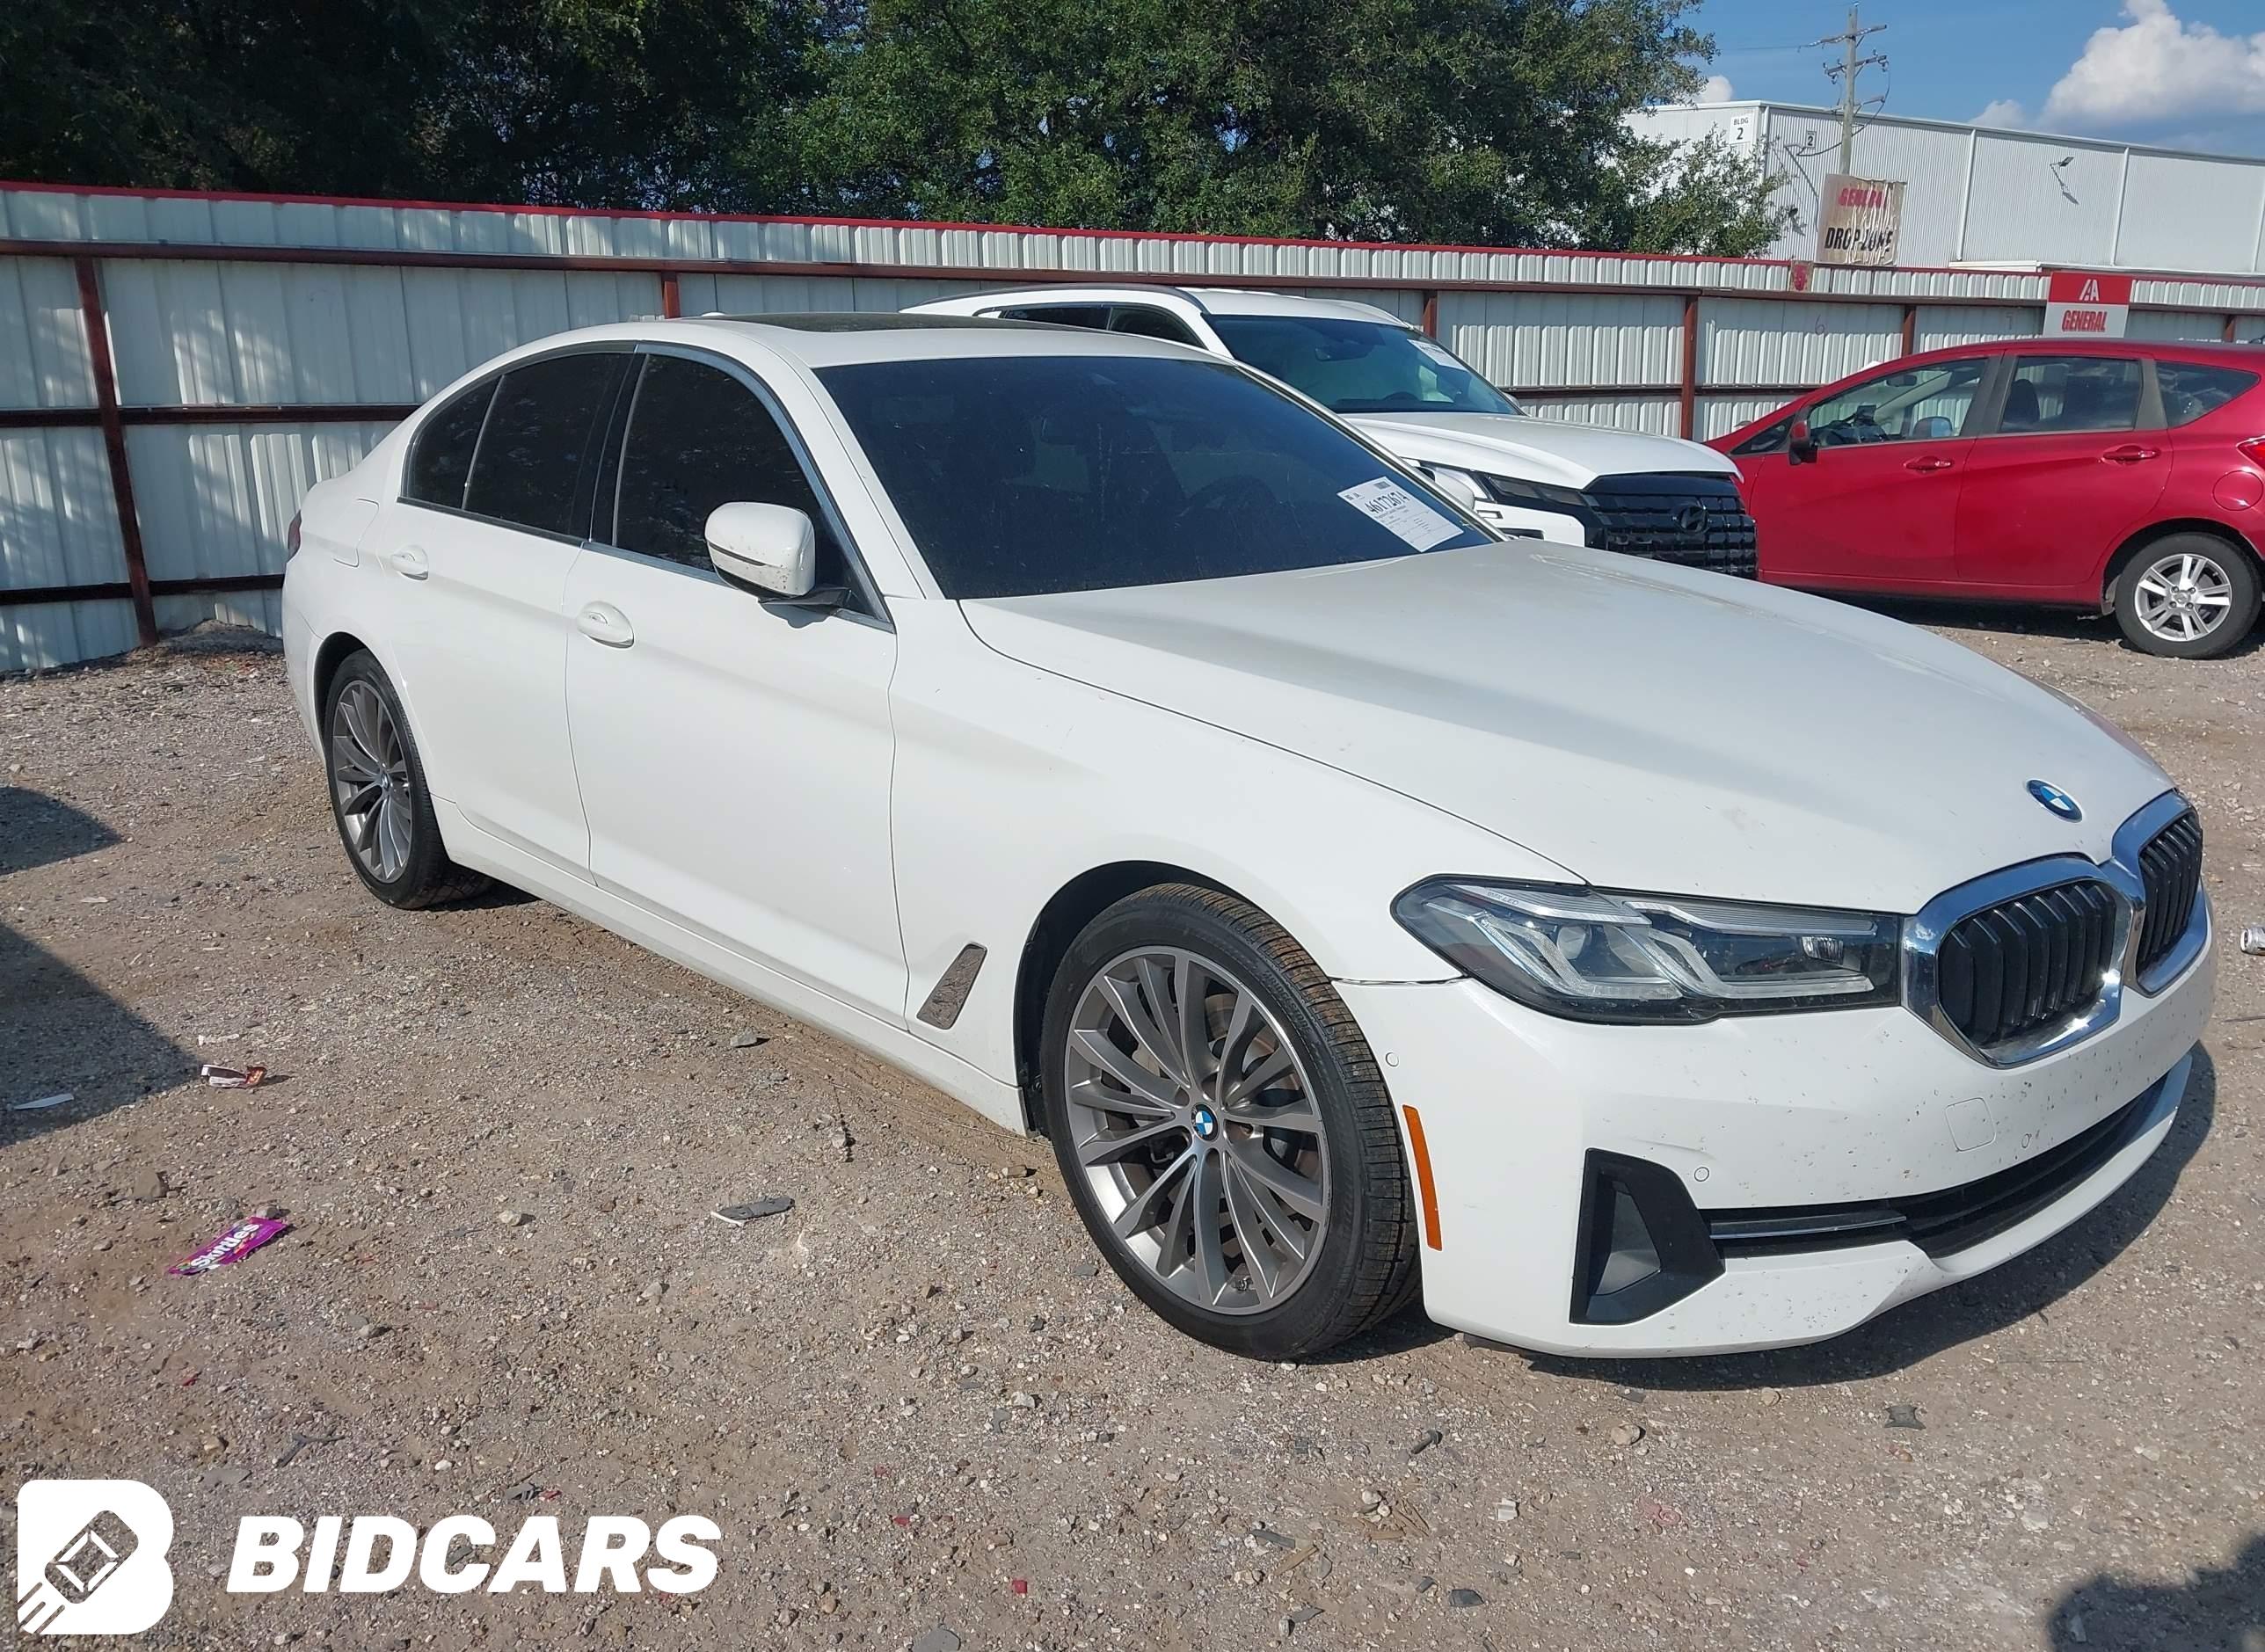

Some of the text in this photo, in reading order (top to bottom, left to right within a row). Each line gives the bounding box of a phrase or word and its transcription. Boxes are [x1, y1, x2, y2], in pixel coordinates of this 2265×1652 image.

[1737, 127, 1744, 140] 2
[1808, 135, 1814, 146] 2
[1824, 227, 1861, 251] DROP
[1815, 314, 1824, 336] 6
[2062, 310, 2108, 332] GENERAL
[1365, 491, 1410, 514] 46172674
